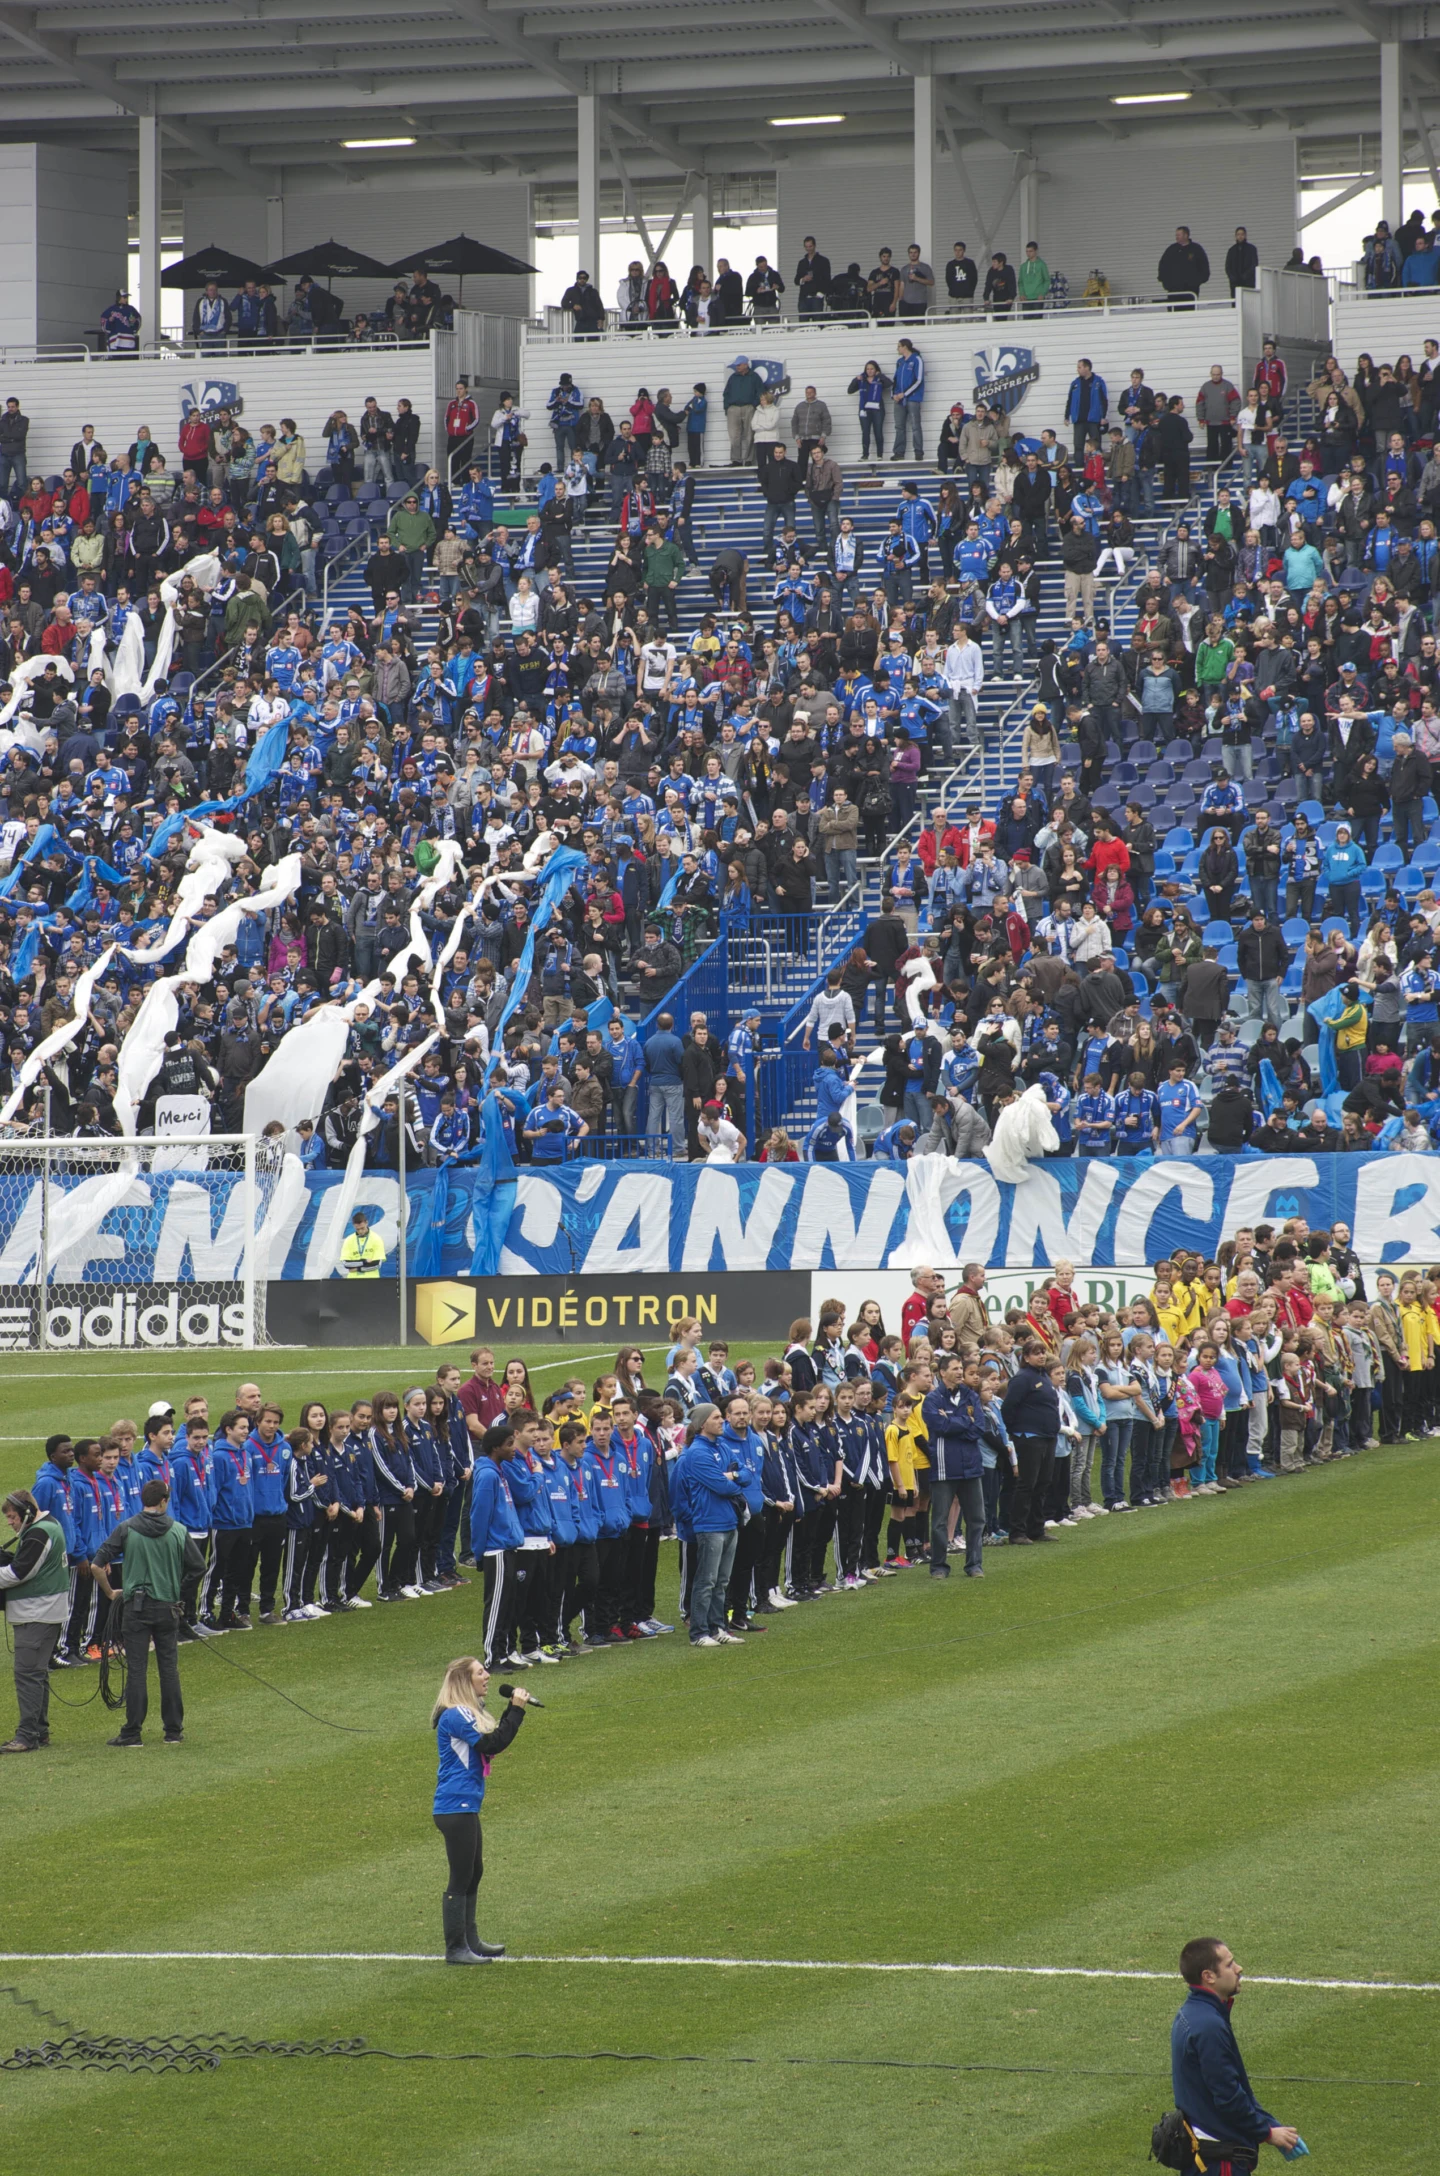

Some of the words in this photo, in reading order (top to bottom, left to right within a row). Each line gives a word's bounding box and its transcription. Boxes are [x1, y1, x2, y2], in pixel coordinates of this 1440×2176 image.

[954, 265, 967, 281] LA
[977, 376, 1010, 393] IMPACT
[977, 372, 1037, 400] MONTRÉAL
[158, 1108, 201, 1127] Merci
[46, 1292, 245, 1347] adidas
[487, 1289, 717, 1328] VIDÉOTRON
